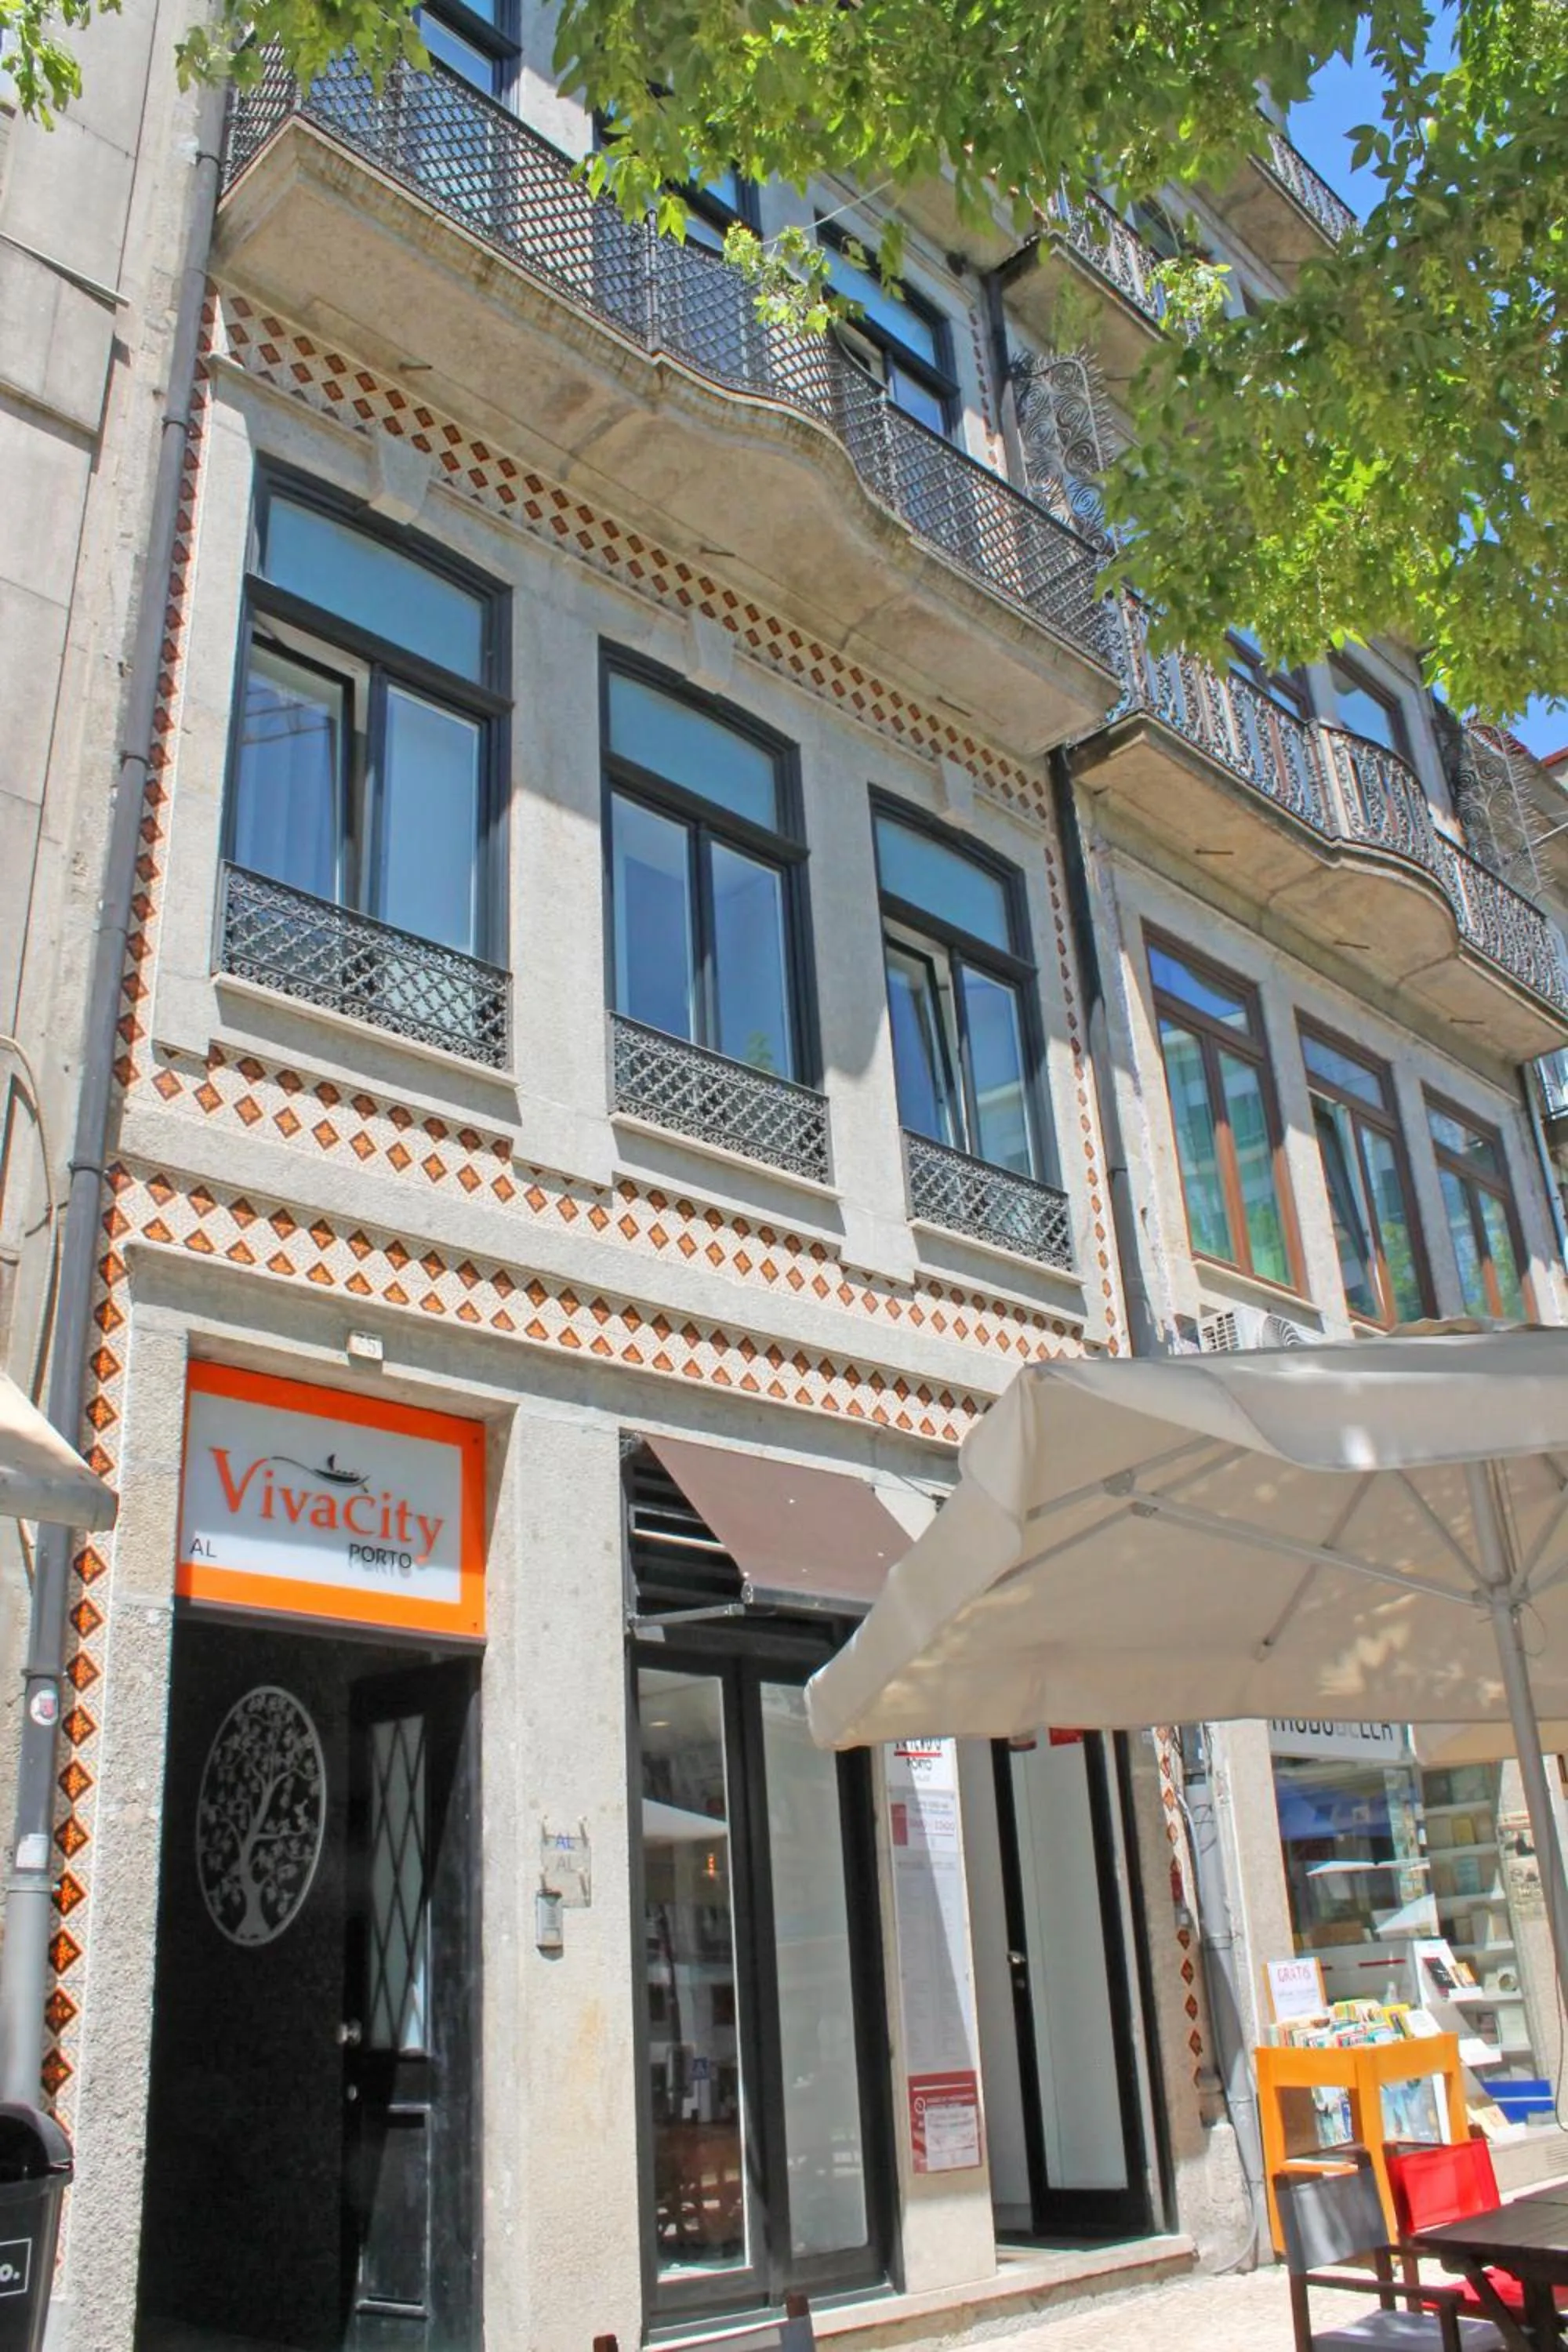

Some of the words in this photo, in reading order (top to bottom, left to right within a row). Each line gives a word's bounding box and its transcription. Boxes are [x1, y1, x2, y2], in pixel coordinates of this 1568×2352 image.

[190, 1537, 217, 1559] AL
[348, 1543, 412, 1569] PORTO
[555, 1831, 575, 1850] AL
